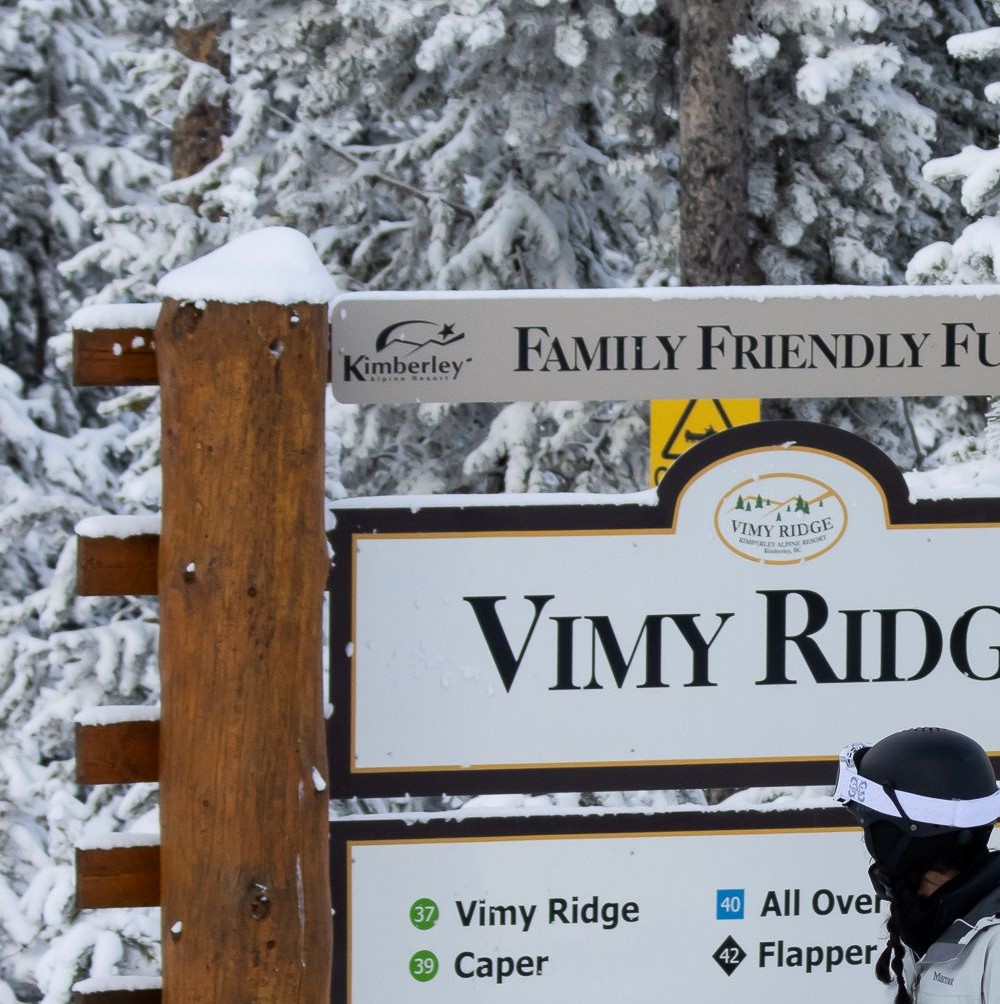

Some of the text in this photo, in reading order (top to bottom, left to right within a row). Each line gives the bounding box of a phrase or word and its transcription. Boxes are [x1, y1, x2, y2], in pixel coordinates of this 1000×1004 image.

[513, 326, 687, 372] FAMILY
[697, 325, 932, 370] FRIENDLY
[344, 355, 464, 381] Kimberley
[732, 516, 834, 538] VIMY RIDGE
[777, 540, 800, 548] ALPINE
[803, 534, 826, 545] RESORT
[462, 594, 735, 694] VIMY
[414, 896, 640, 932] 37 Vimy Ridge
[720, 896, 741, 912] 40
[760, 889, 800, 917] All
[414, 952, 549, 984] 39 Caper
[719, 940, 878, 973] 42 Flapper
